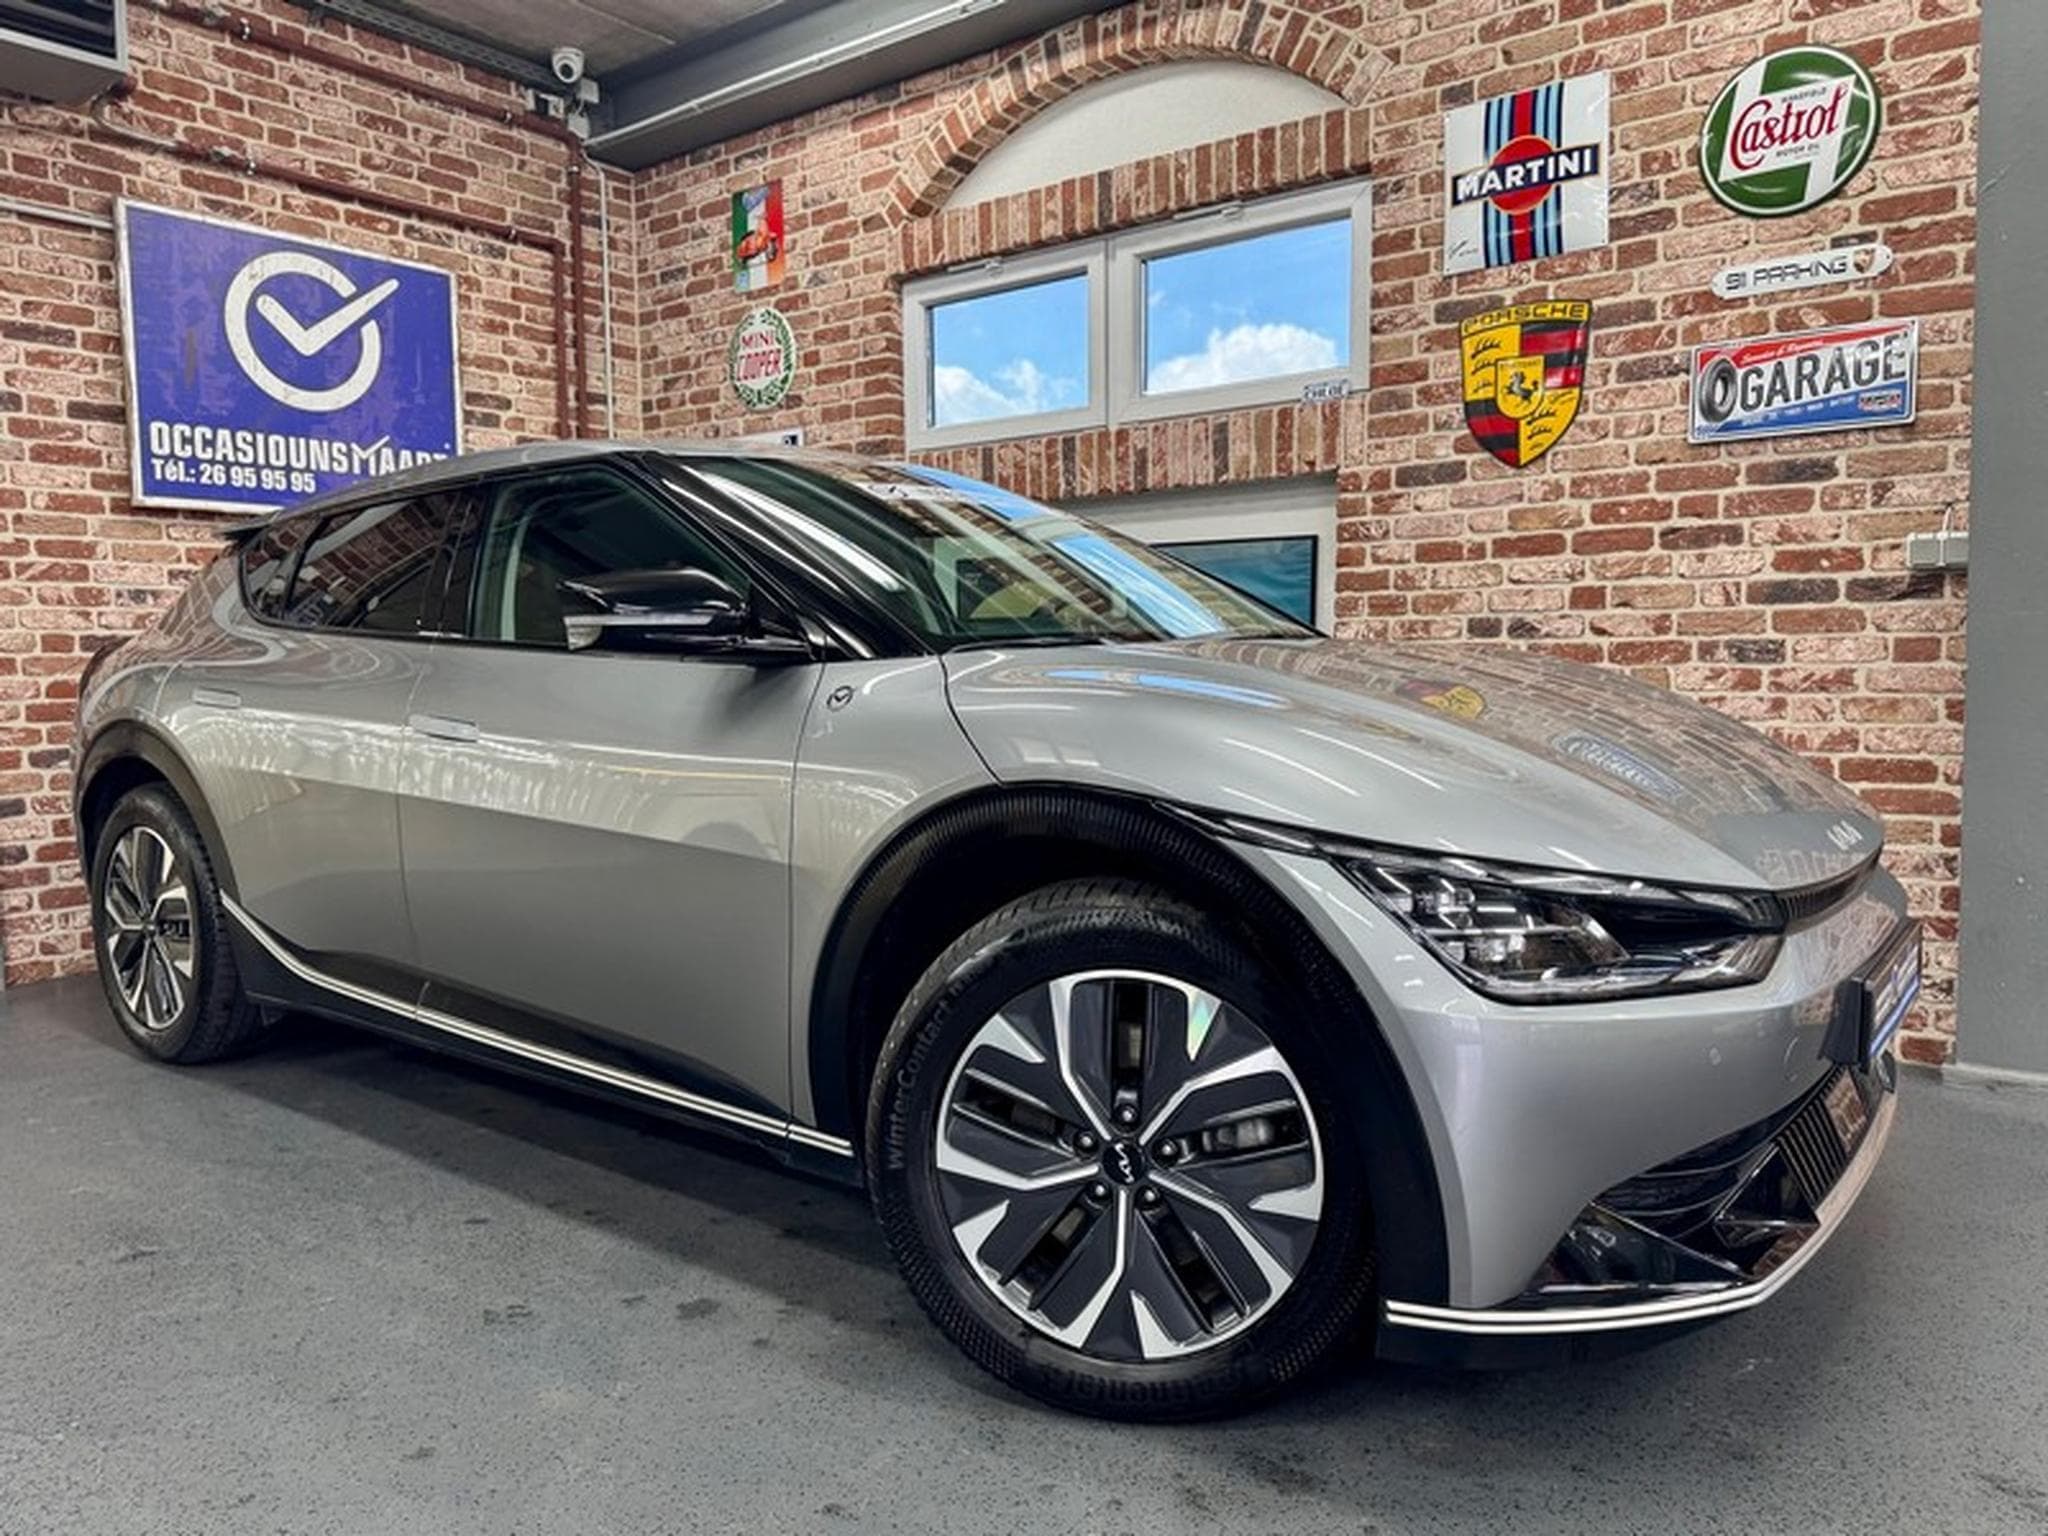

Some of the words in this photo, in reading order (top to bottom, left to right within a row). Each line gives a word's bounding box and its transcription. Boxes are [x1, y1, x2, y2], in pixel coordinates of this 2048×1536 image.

[1730, 83, 1848, 171] Castrol
[1456, 149, 1592, 201] MARTINI
[1753, 256, 1848, 286] PARKING
[1464, 303, 1586, 334] PORSCHE
[741, 329, 775, 349] MINI
[737, 348, 782, 382] COOPER
[199, 463, 227, 487] 26
[230, 466, 257, 490] 95
[260, 470, 288, 492] 95
[290, 473, 317, 494] 95
